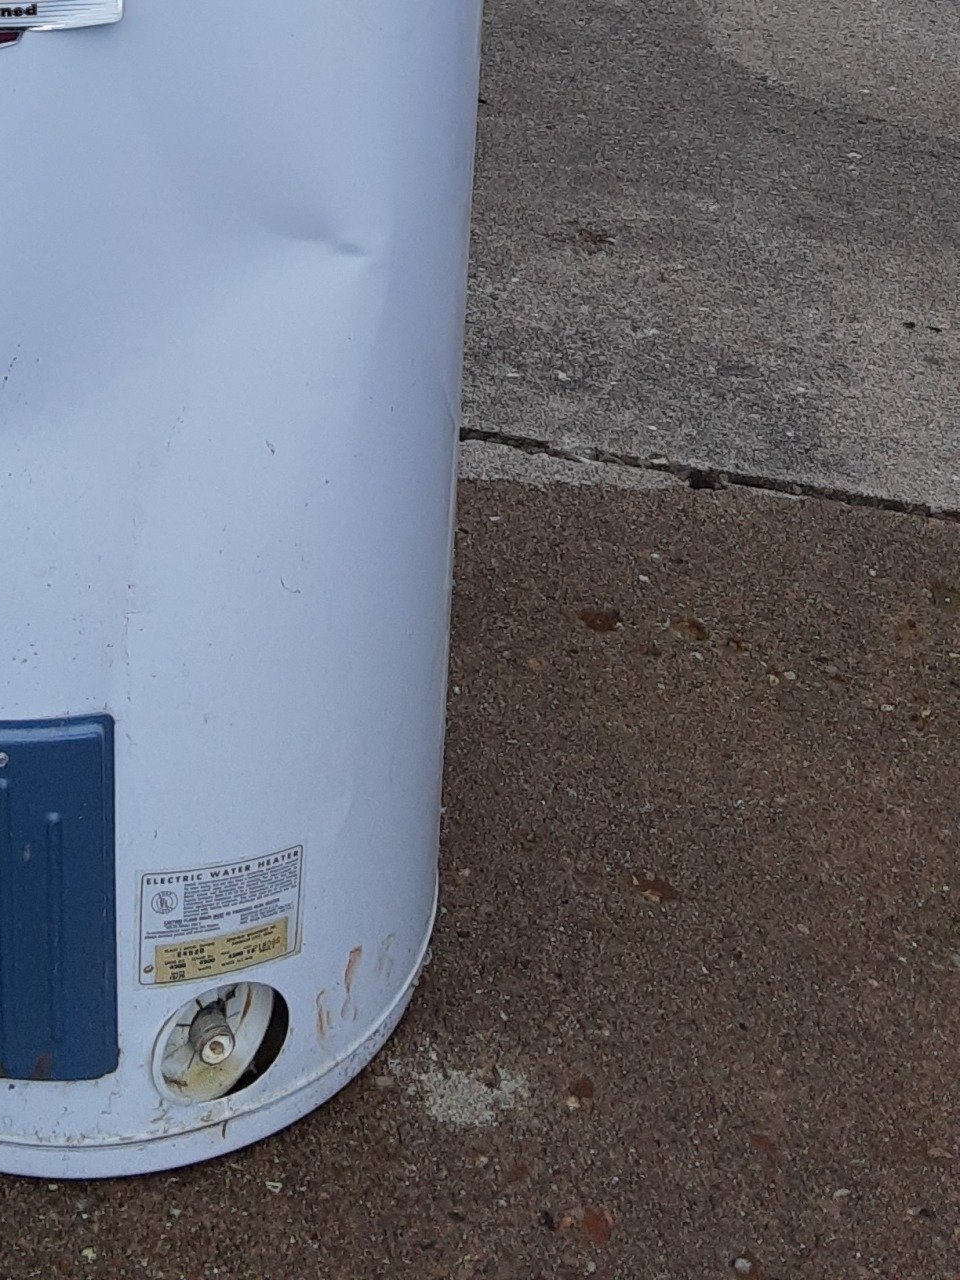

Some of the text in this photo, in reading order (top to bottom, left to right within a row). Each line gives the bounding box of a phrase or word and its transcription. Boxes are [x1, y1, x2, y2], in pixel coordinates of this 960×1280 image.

[146, 850, 300, 885] ELECTRIC WATER HEATER
